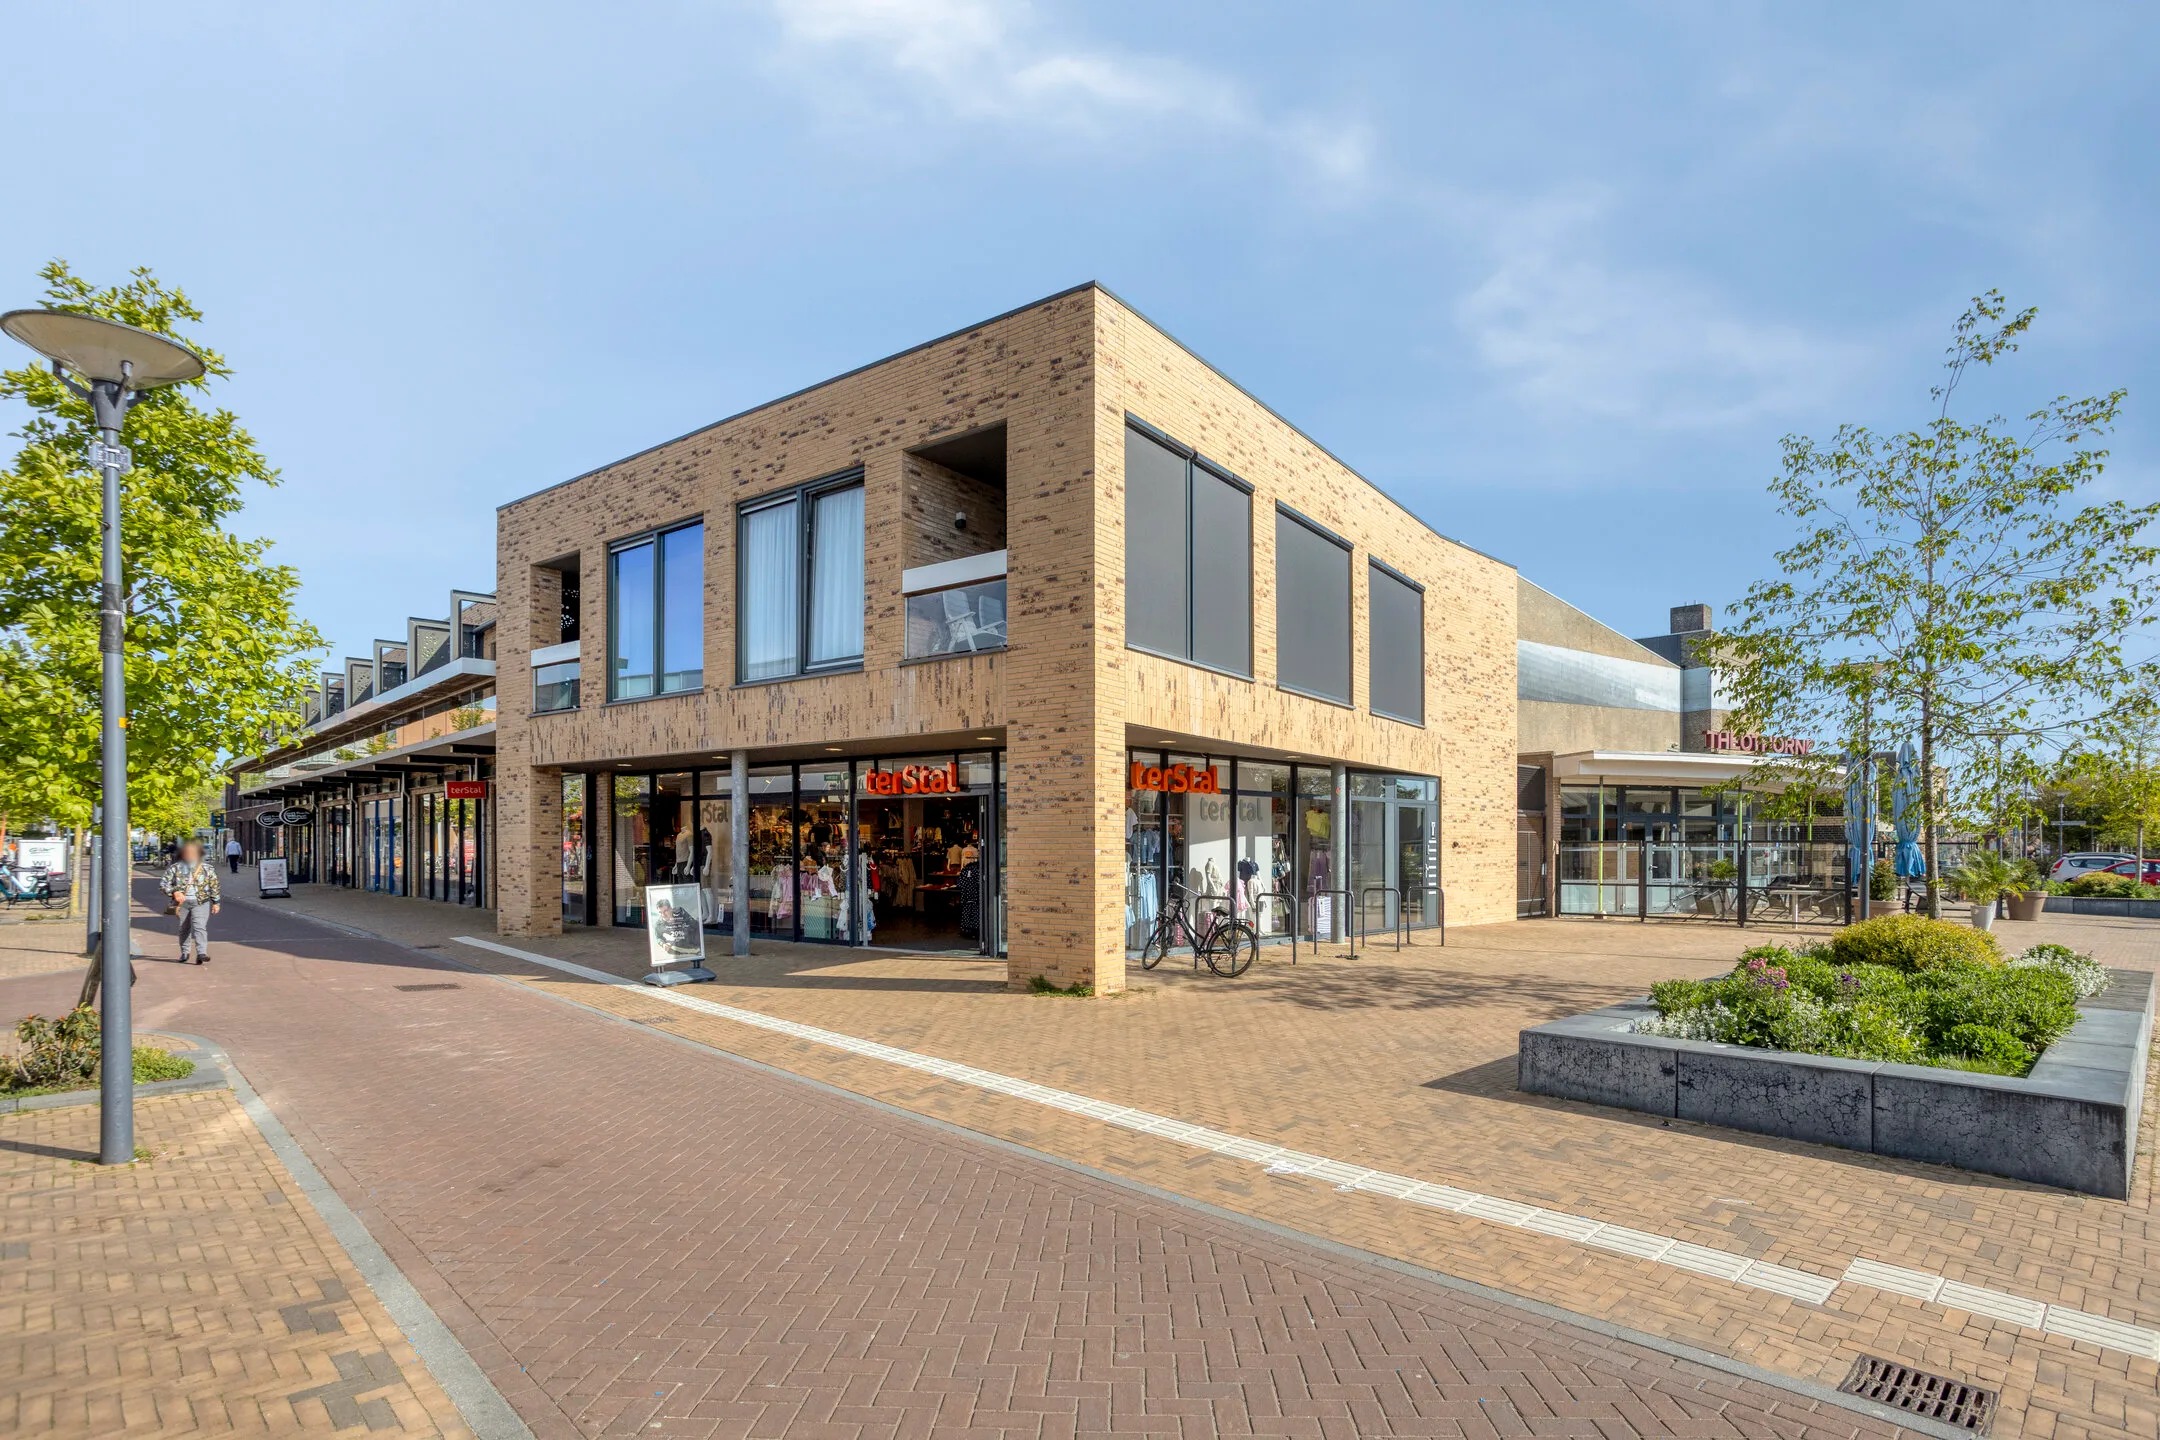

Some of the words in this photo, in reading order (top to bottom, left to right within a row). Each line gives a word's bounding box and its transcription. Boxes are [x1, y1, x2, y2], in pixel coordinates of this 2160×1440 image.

[865, 762, 960, 795] terStal
[1130, 760, 1222, 794] terStal
[450, 786, 482, 794] terStal
[701, 801, 729, 823] rStal
[1200, 796, 1263, 821] tertal
